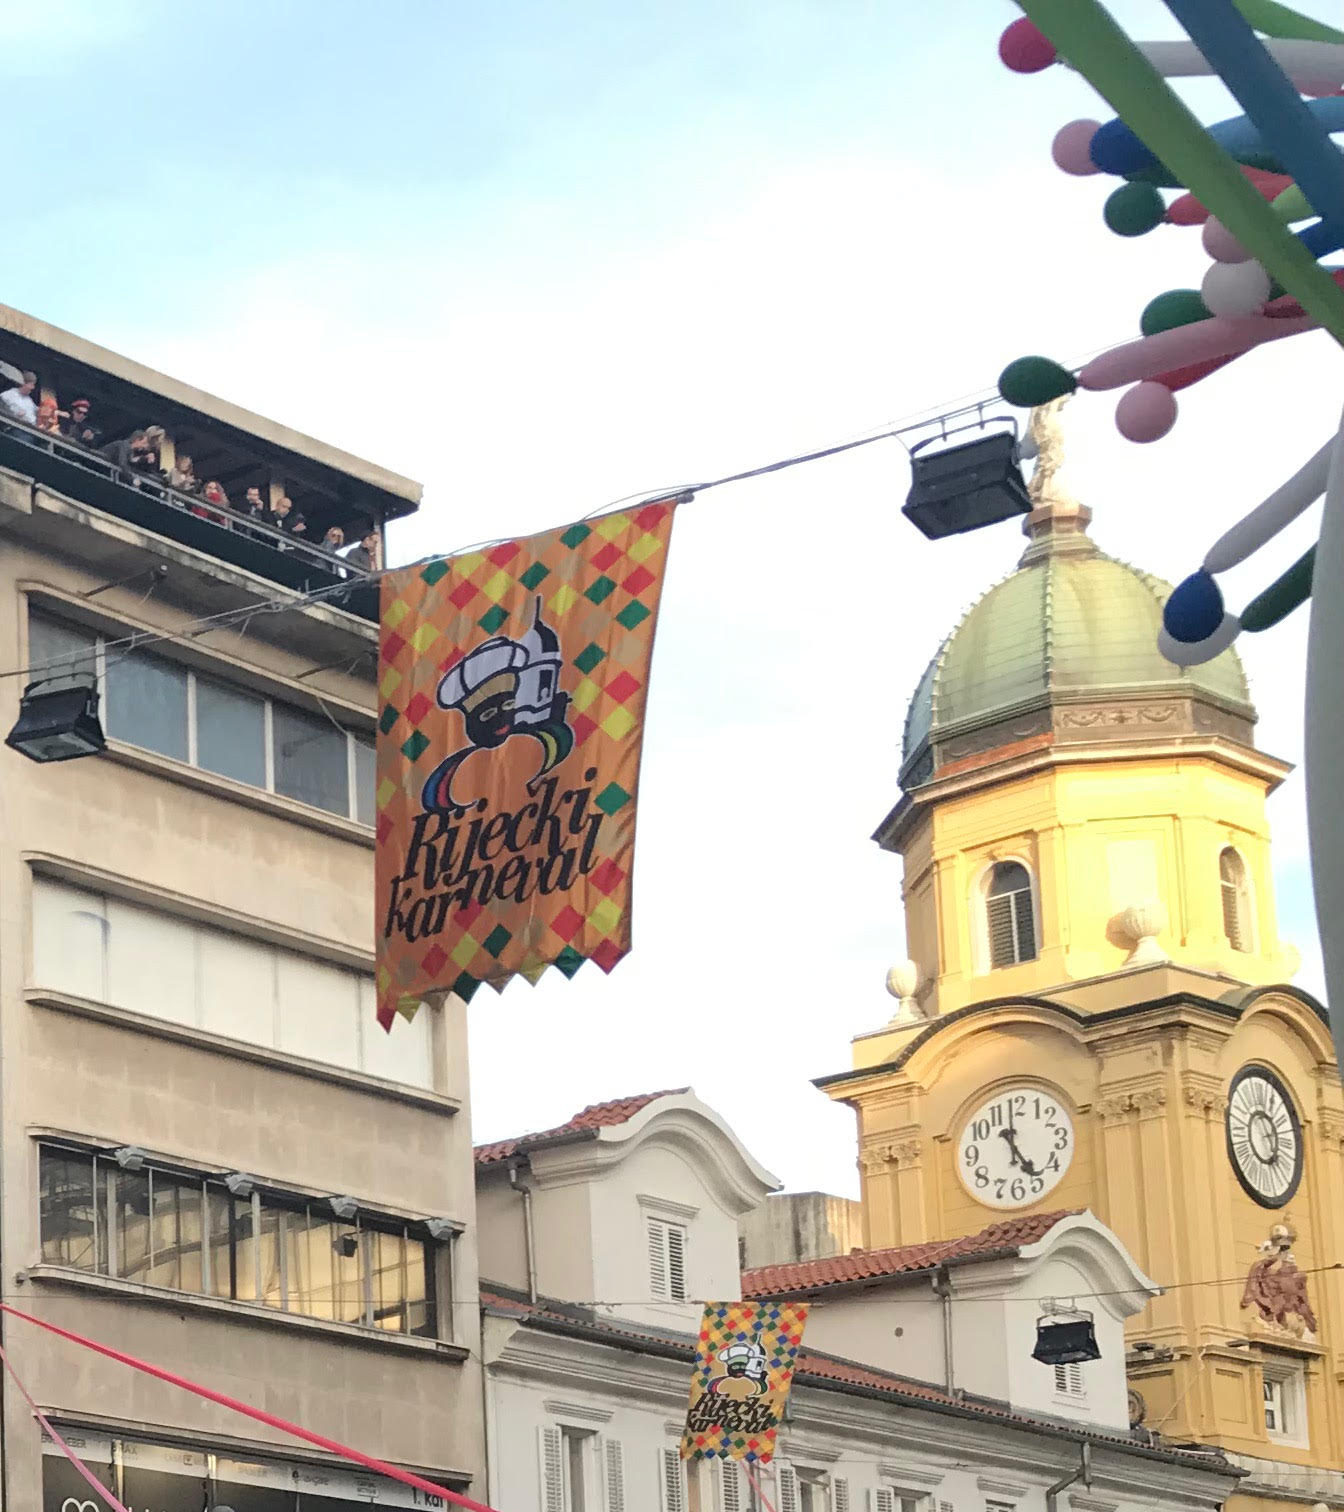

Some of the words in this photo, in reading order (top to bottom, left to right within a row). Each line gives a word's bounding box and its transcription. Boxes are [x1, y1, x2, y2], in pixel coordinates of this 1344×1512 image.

[385, 813, 604, 943] karneval
[988, 1103, 1003, 1127] 11
[1033, 1097, 1040, 1119] 1
[1044, 1106, 1057, 1128] 2
[971, 1118, 990, 1141] 10
[1054, 1127, 1068, 1150] 3
[965, 1144, 979, 1167] 9
[1045, 1151, 1060, 1172] 4
[974, 1165, 989, 1188] 8
[994, 1178, 1007, 1199] 7
[1011, 1178, 1025, 1201] 6
